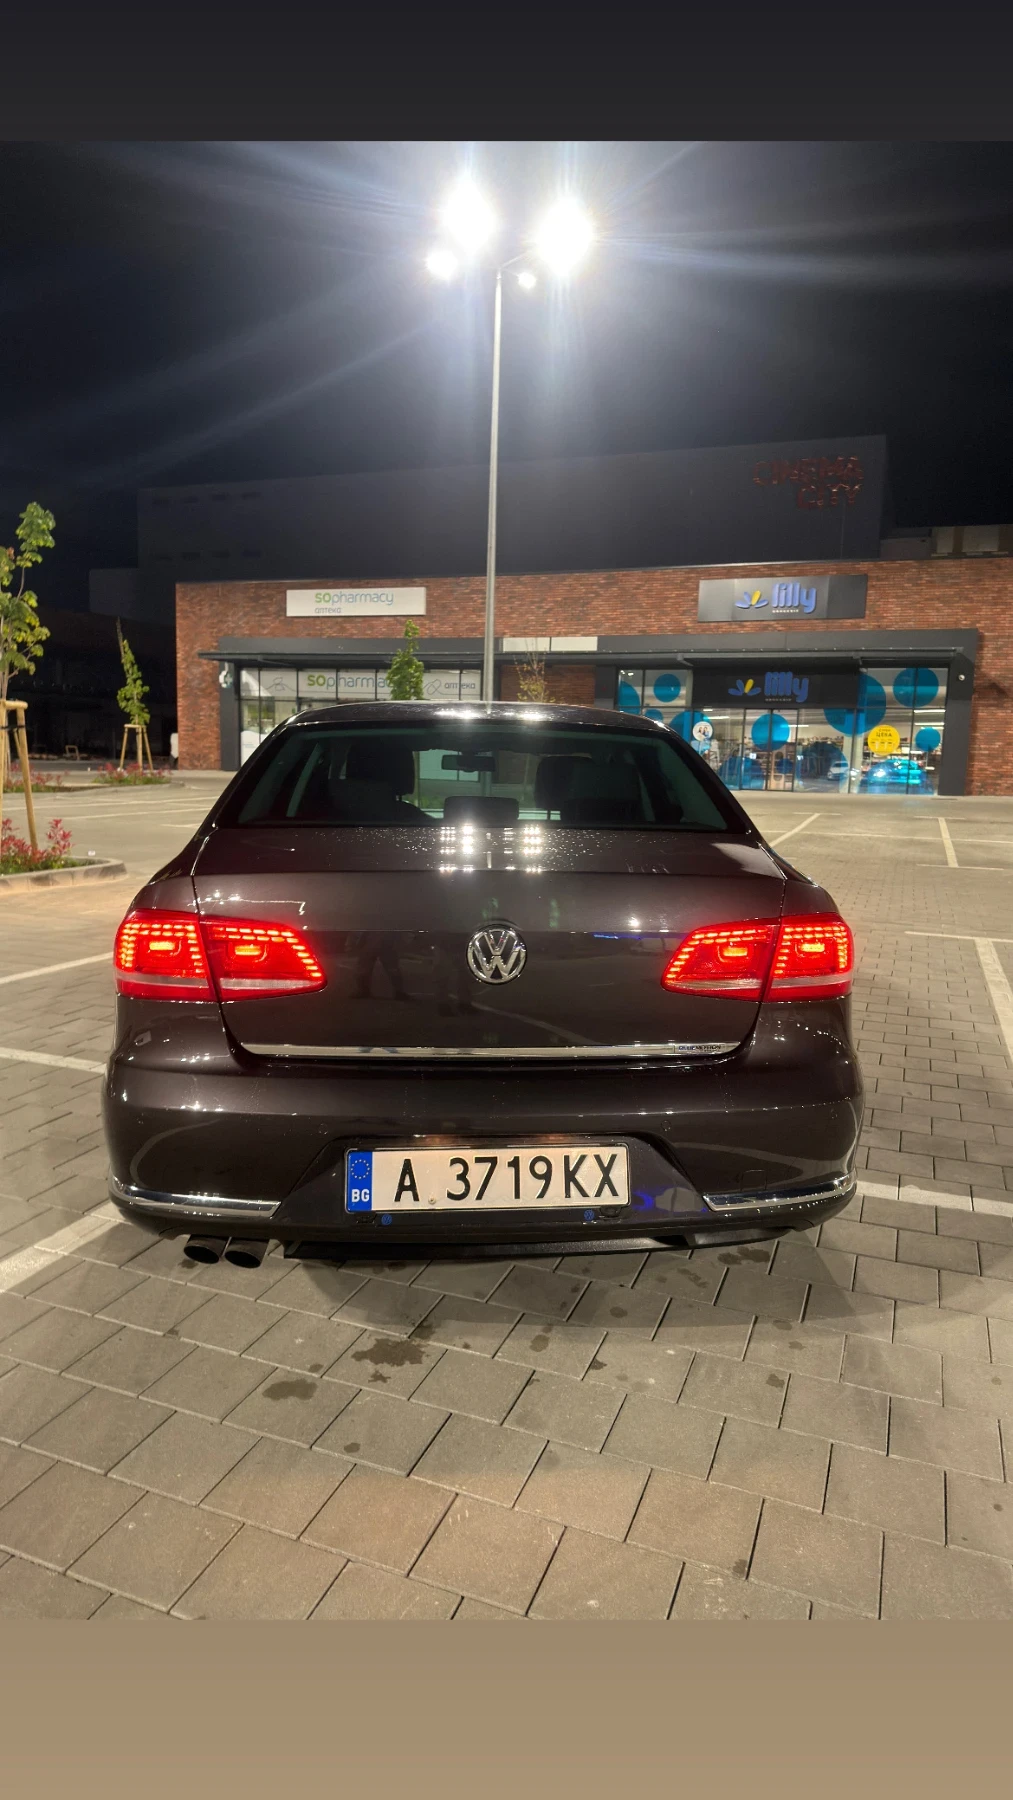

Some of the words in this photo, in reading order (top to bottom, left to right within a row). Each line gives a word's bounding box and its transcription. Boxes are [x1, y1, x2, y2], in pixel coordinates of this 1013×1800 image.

[753, 457, 864, 486] CINEMA
[797, 484, 862, 509] CITY
[314, 592, 394, 606] sopharmacy
[772, 583, 817, 614] lilly
[307, 674, 394, 690] sopharmac
[764, 671, 809, 703] lilly
[467, 928, 527, 984] VW
[394, 1158, 420, 1202] A
[351, 1189, 370, 1202] BG
